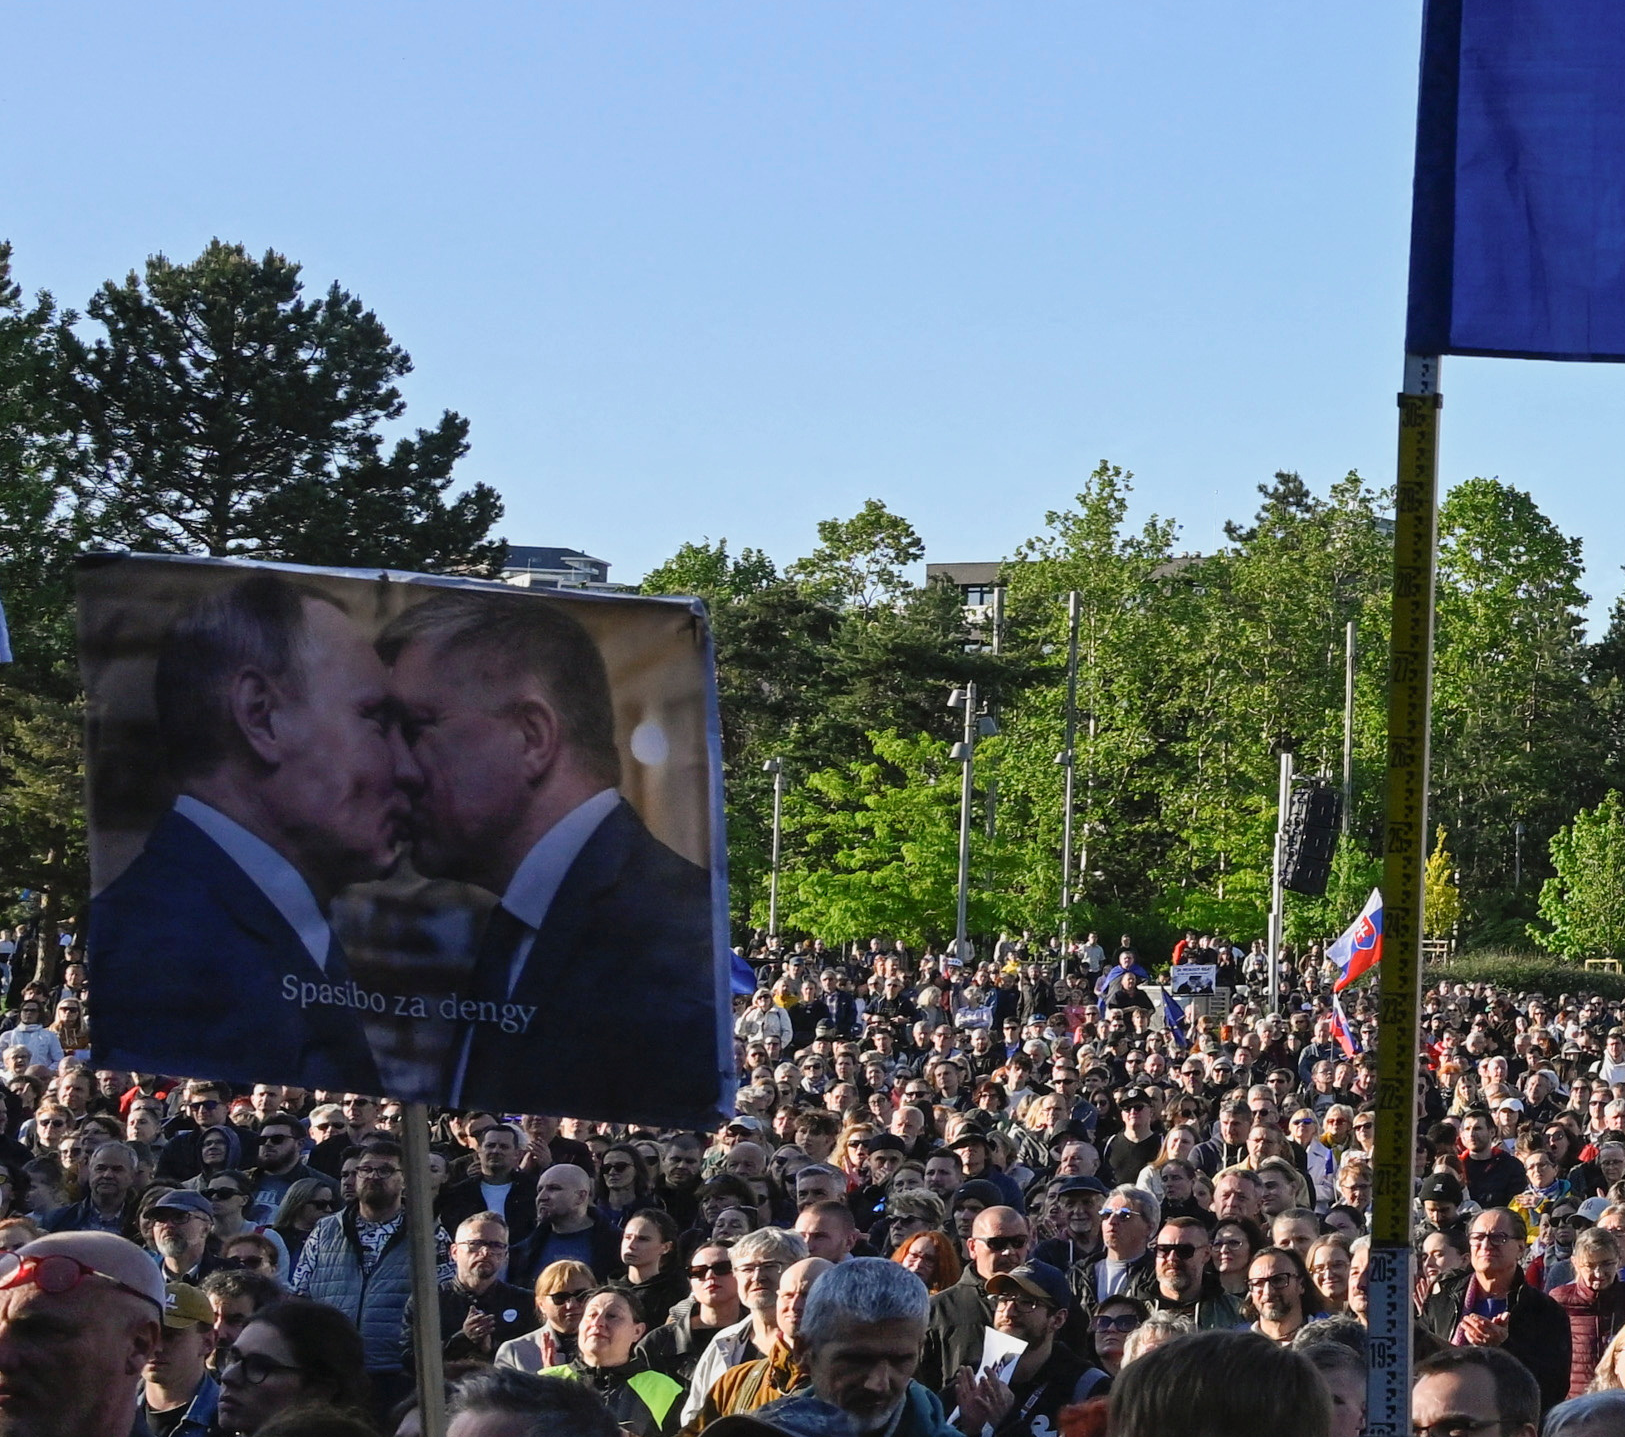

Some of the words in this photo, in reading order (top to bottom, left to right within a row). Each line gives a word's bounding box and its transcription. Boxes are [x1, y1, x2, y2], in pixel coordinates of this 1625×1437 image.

[281, 974, 386, 1013] Spasibo
[393, 995, 428, 1018] za
[438, 992, 539, 1034] dengy
[1370, 1256, 1386, 1283] 20
[1370, 1342, 1386, 1369] 19
